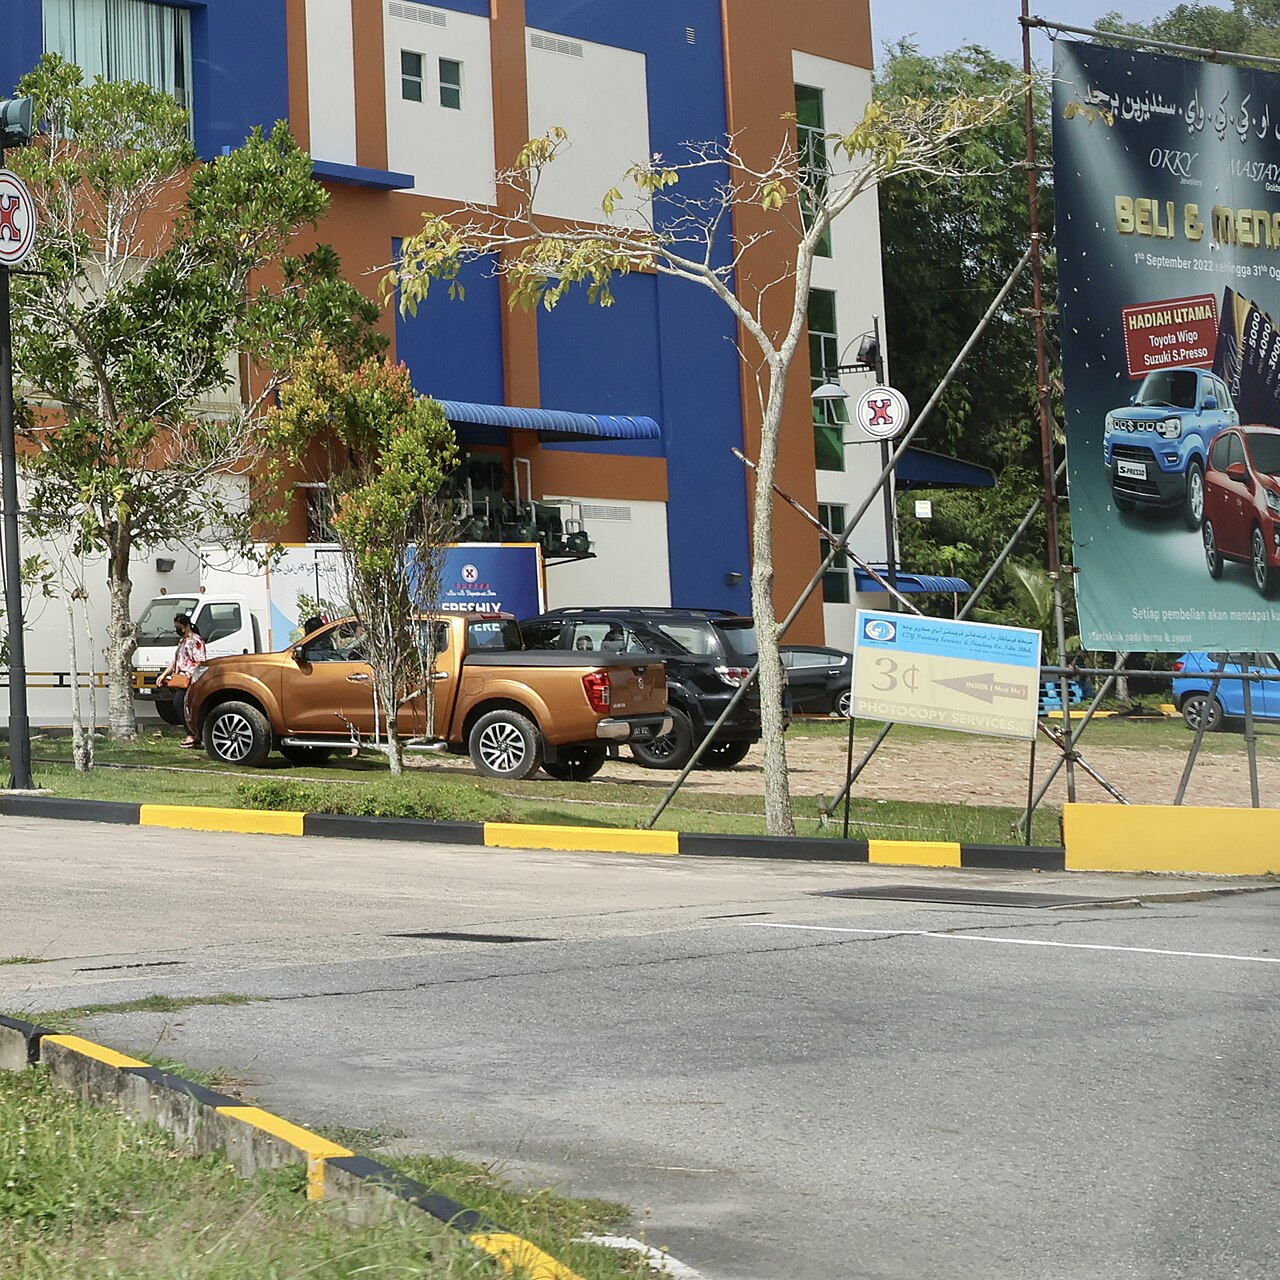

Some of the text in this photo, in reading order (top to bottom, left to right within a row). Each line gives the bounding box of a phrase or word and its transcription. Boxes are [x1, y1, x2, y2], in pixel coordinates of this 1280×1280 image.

[1149, 148, 1199, 176] OKKY
[1114, 195, 1175, 240] BELI
[1184, 203, 1204, 240] &
[1146, 254, 1191, 269] September
[1193, 259, 1213, 272] 2022
[1129, 305, 1213, 330] HADIAH UTAMA
[1149, 330, 1198, 348] Toyota Wigo
[1248, 312, 1261, 348] 5000
[1259, 323, 1271, 358] 4000
[1144, 347, 1208, 366] Suzuki S.Presso
[1132, 607, 1160, 621] Setiap
[1162, 608, 1206, 622] pembelian
[1207, 609, 1228, 621] akan
[1230, 609, 1270, 623] mendapat
[859, 701, 948, 721] PHOTOCOPY
